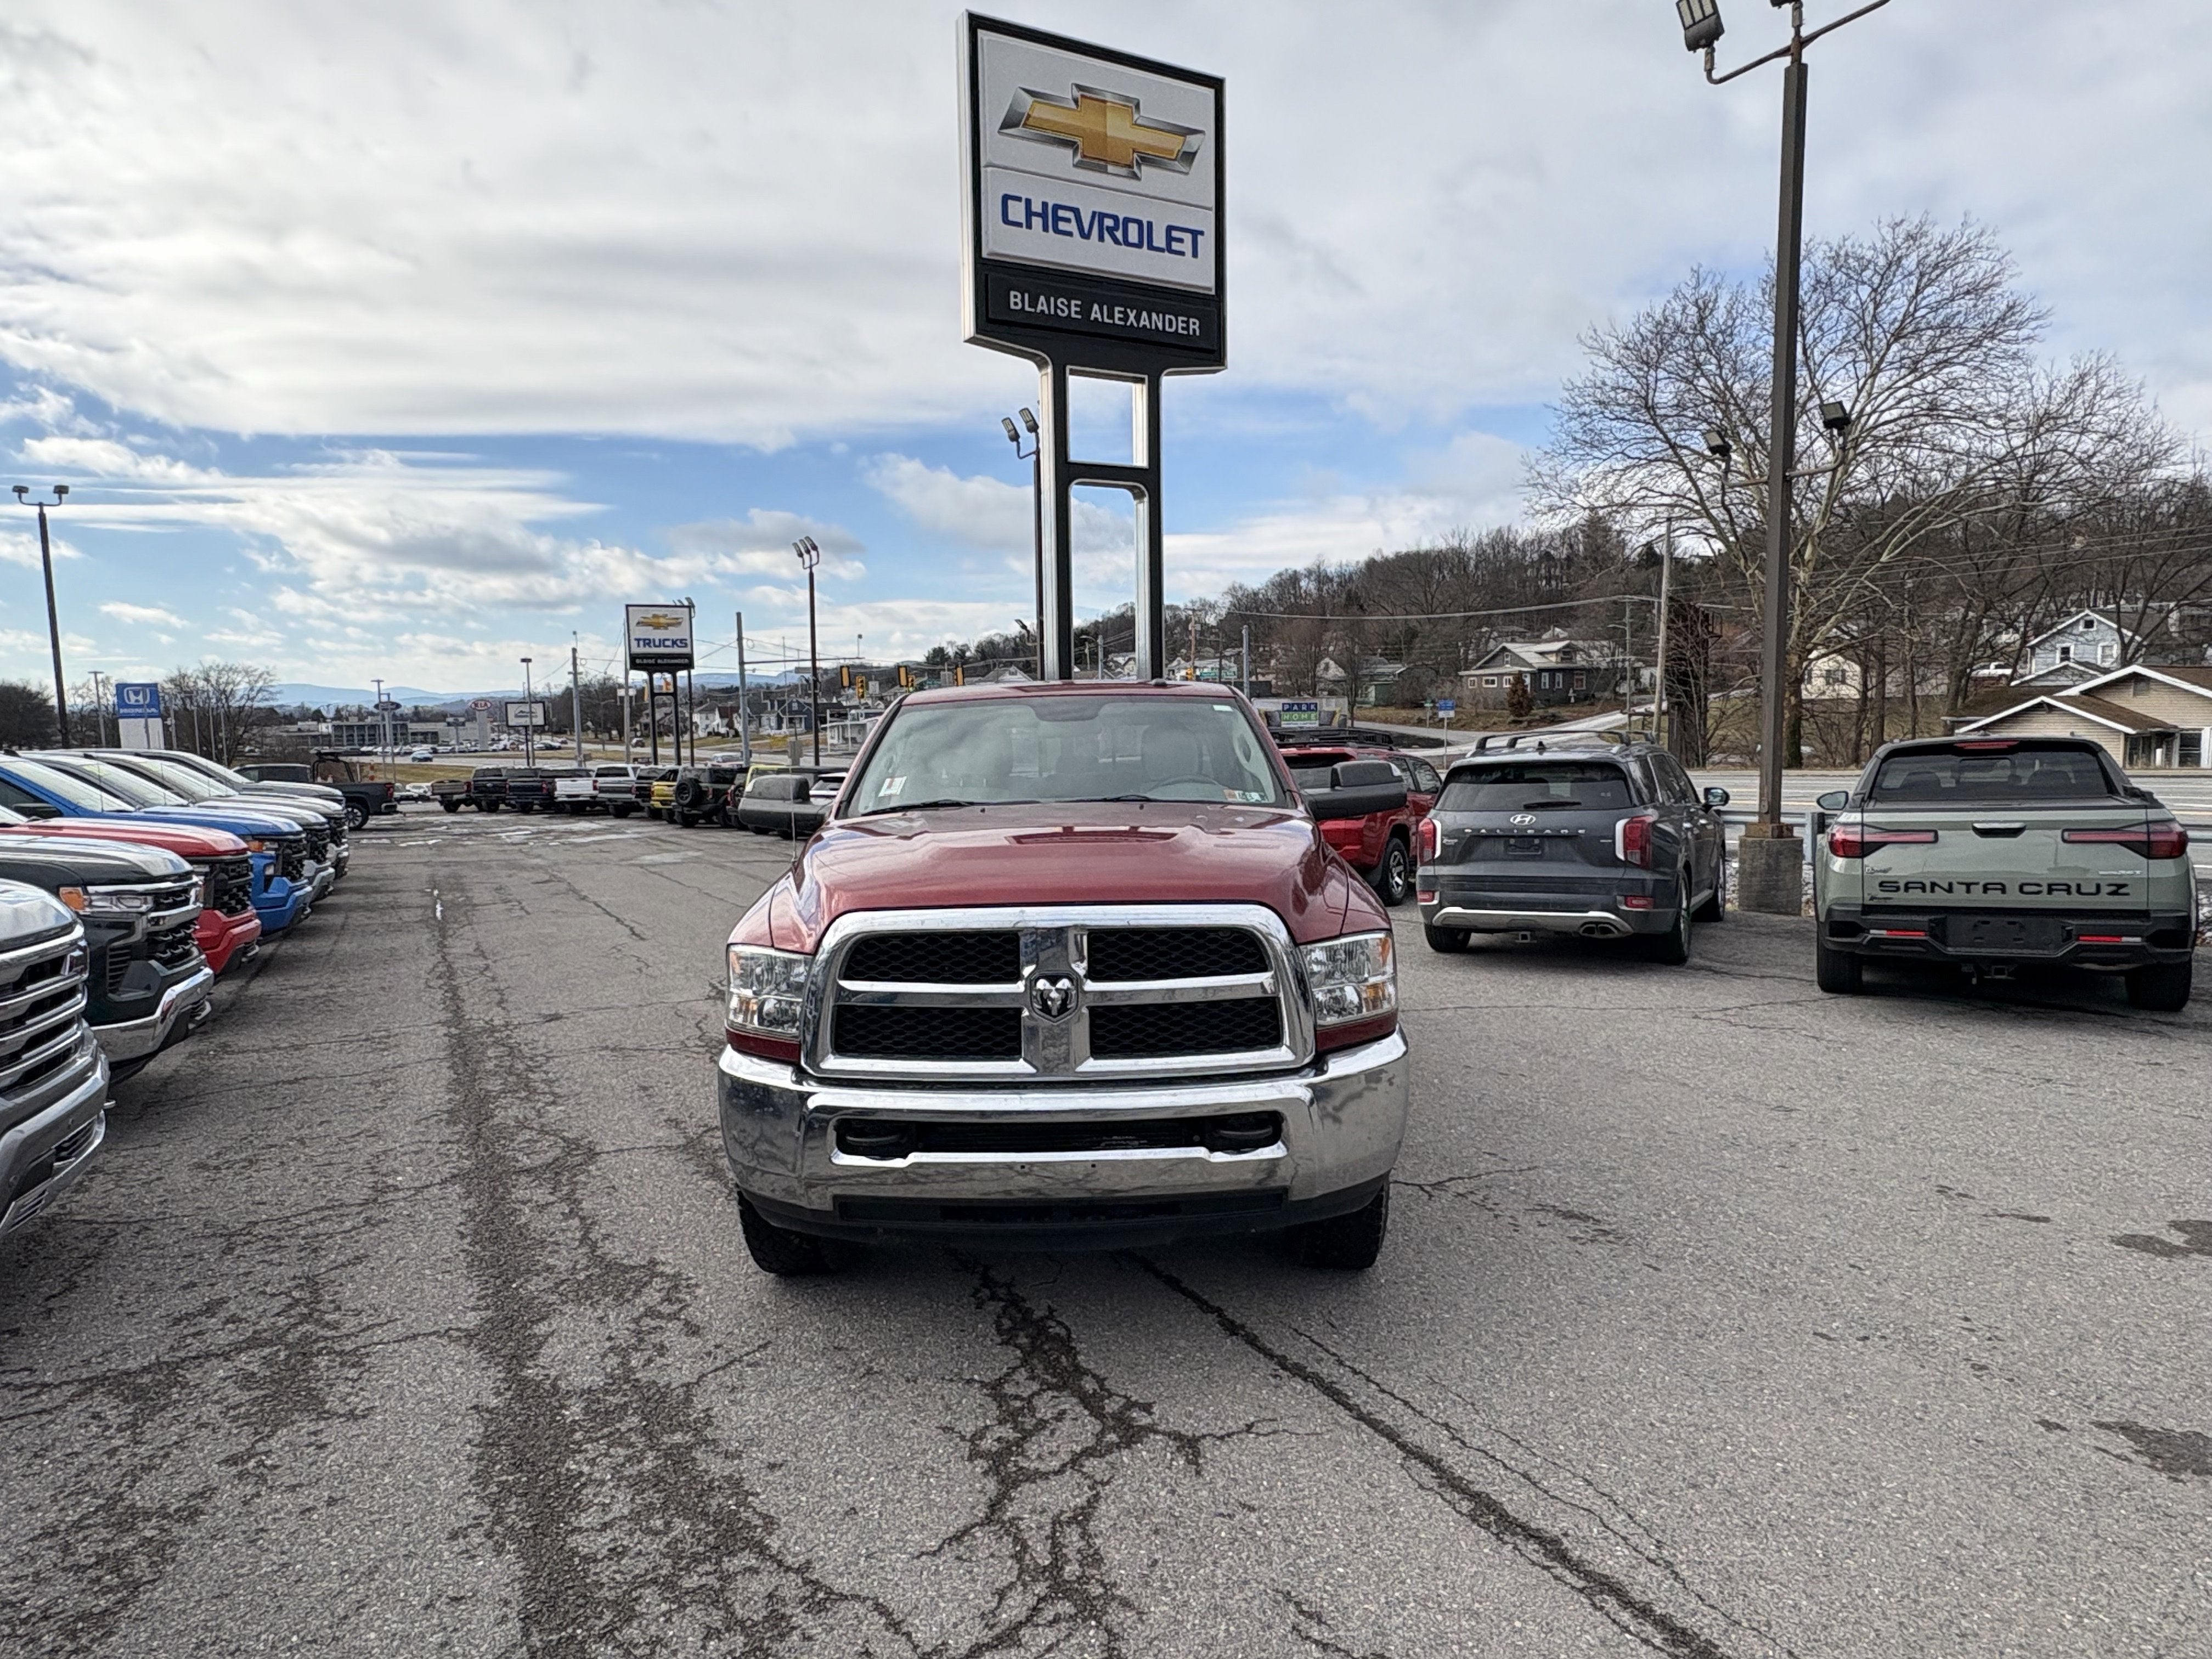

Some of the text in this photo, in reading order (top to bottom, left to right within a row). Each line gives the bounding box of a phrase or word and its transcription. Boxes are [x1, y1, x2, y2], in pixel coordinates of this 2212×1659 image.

[1001, 193, 1204, 258] CHEVROLET
[1009, 290, 1200, 336] BLAISE ALEXANDER
[634, 637, 689, 648] TRUCKS
[1878, 881, 2131, 896] SANTA CRUZ
